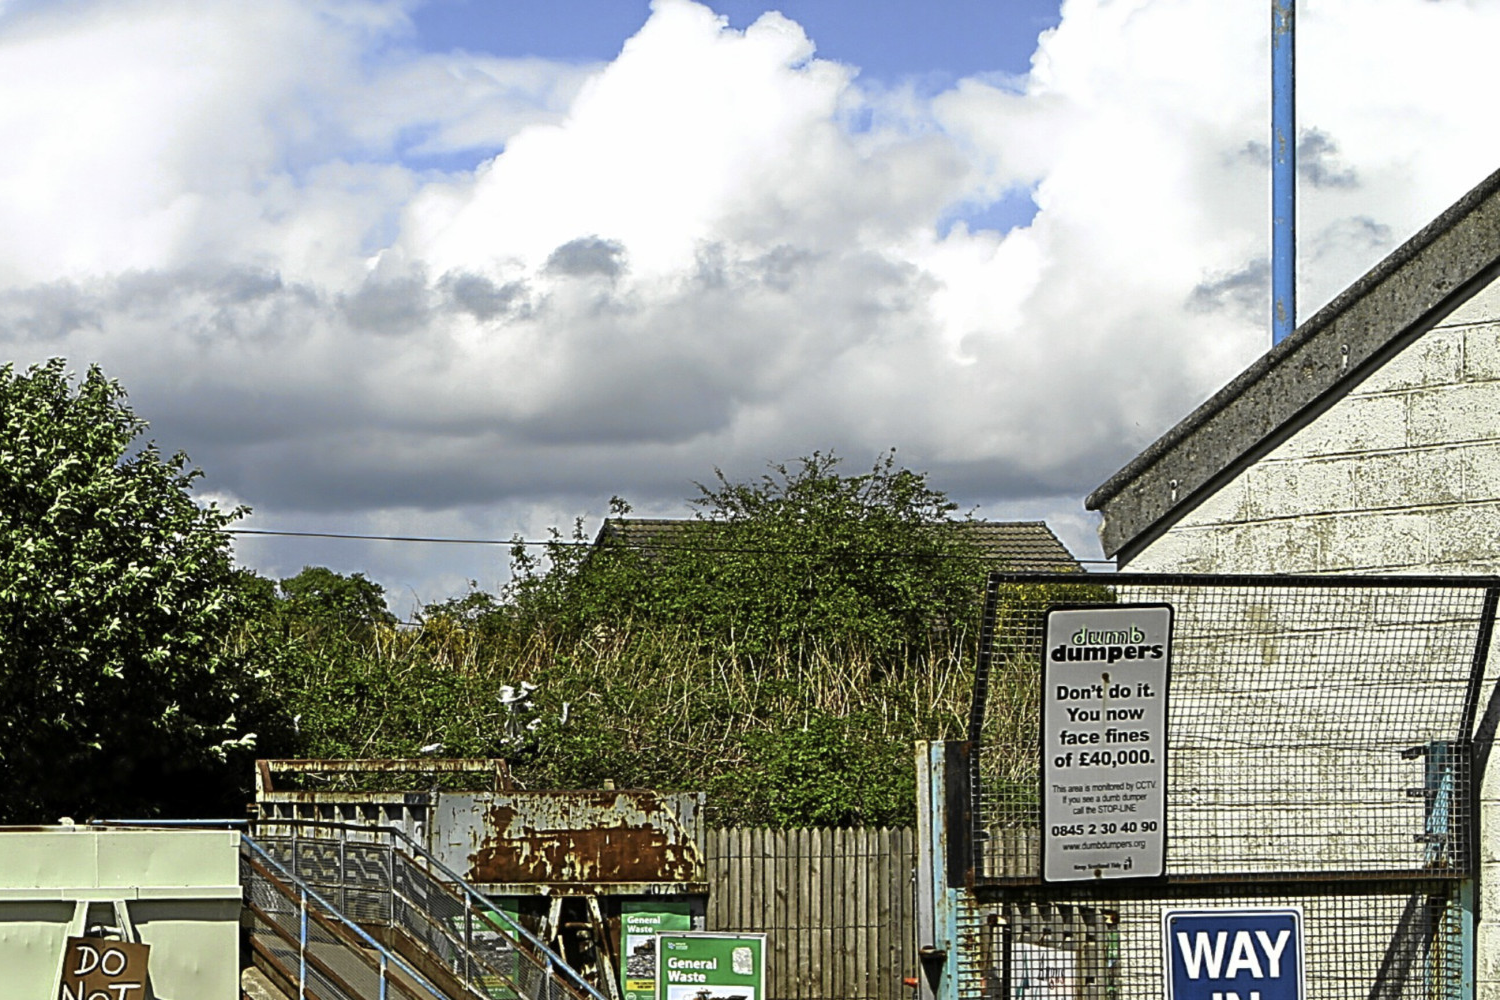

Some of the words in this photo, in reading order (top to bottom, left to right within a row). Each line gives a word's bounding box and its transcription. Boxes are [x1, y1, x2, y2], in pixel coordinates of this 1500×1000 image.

[1072, 625, 1145, 645] dumb
[1051, 644, 1163, 663] dumpers
[1057, 684, 1104, 700] Don't
[1109, 684, 1131, 699] do
[1137, 683, 1155, 698] it.
[1066, 708, 1100, 722] You
[1106, 708, 1145, 720] now
[1060, 730, 1099, 745] face
[1105, 729, 1150, 743] fines
[1054, 753, 1073, 767] of
[1079, 750, 1155, 768] £40,000.
[1052, 784, 1067, 793] This
[1068, 785, 1083, 793] area
[1092, 782, 1125, 792] monitored
[1126, 783, 1134, 792] by
[1068, 797, 1080, 805] you
[1102, 794, 1120, 802] dumb
[1122, 793, 1147, 803] dumper
[1073, 806, 1085, 815] call
[1086, 805, 1096, 814] the
[1097, 804, 1137, 813] STOP-LINE
[1051, 824, 1084, 837] 0845
[1088, 824, 1097, 835] 2
[1100, 823, 1117, 834] 30
[1120, 822, 1138, 833] 40
[1140, 821, 1158, 832] 90
[1062, 840, 1146, 851] www.dumbdumpers.org
[627, 916, 661, 925] General
[627, 925, 653, 933] Waste
[74, 944, 126, 976] DO
[1177, 930, 1291, 980] WAY
[668, 957, 717, 970] General
[668, 970, 706, 983] Waste
